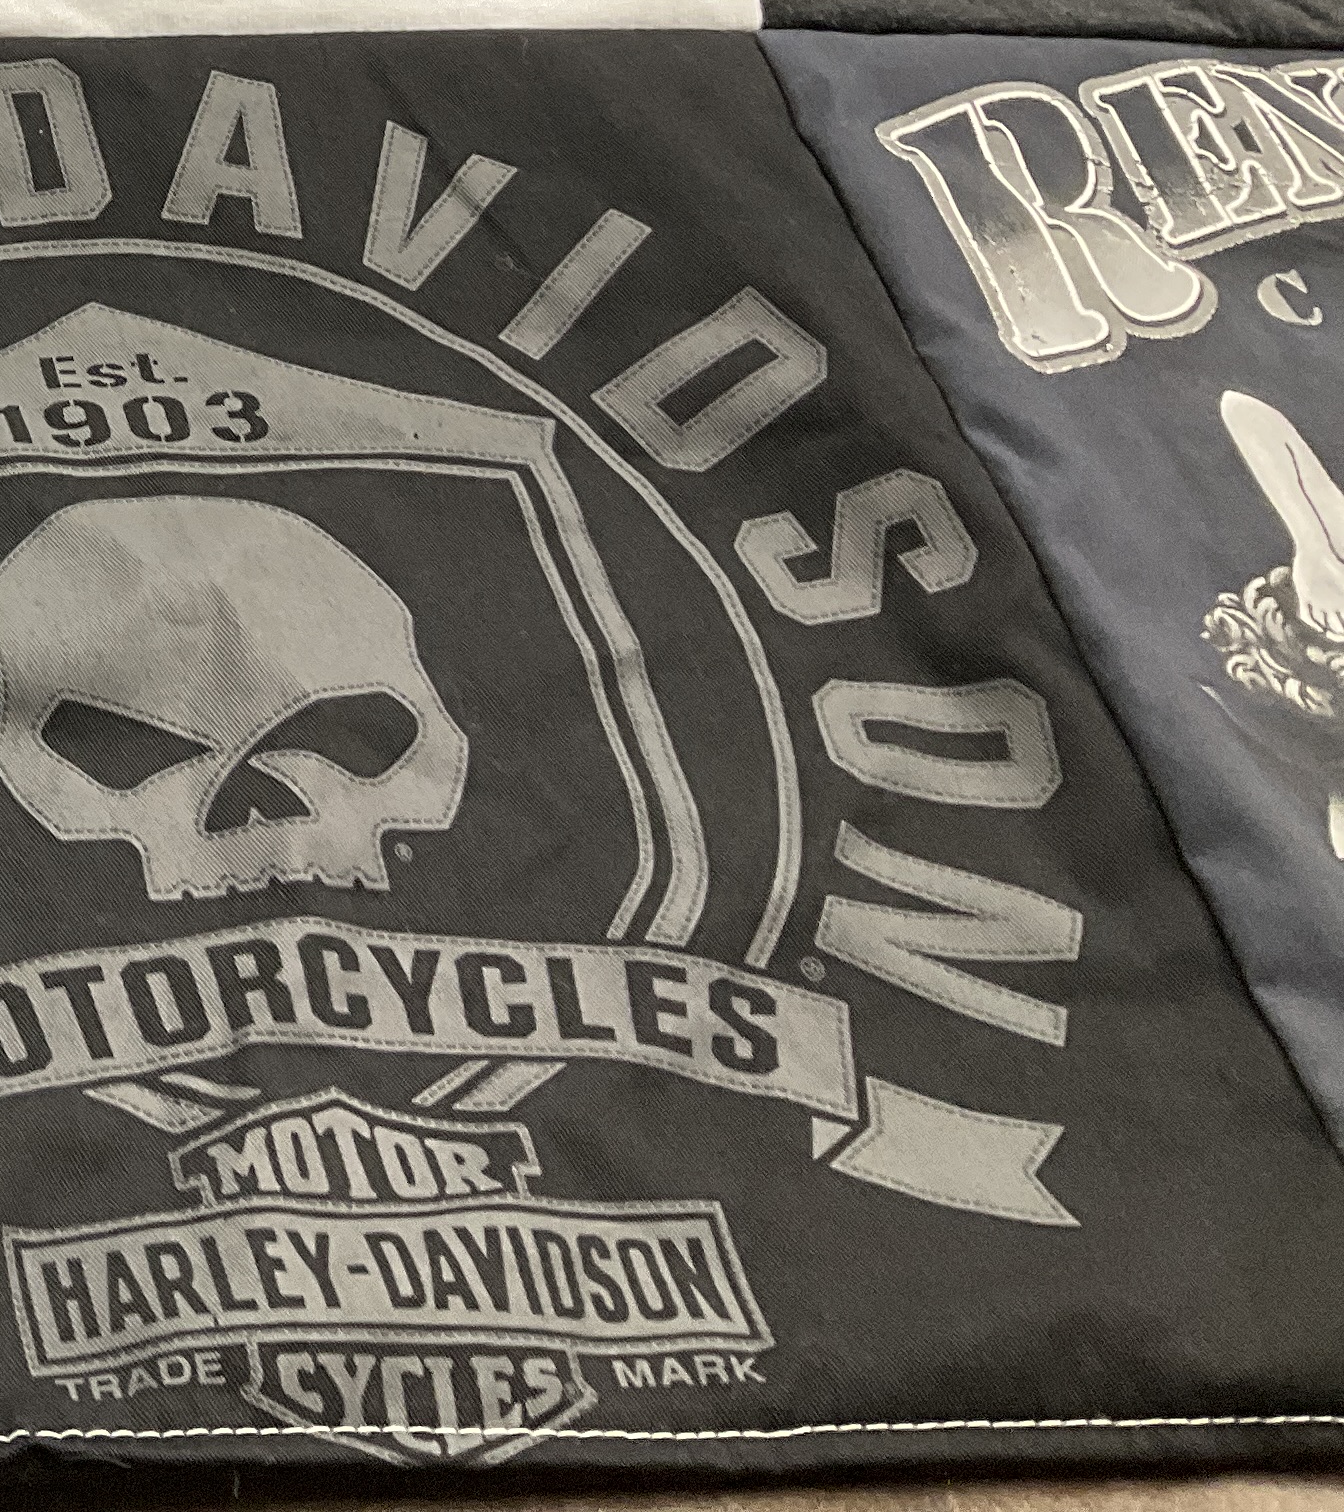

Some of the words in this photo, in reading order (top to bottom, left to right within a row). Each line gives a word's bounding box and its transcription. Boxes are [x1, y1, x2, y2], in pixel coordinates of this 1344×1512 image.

[38, 352, 190, 390] Est.
[205, 1106, 503, 1202] MOTOR
[39, 1224, 734, 1346] HARLEY-DAVIDSON
[54, 1350, 228, 1403] TRADE
[611, 1355, 767, 1391] MARK
[276, 1350, 569, 1456] CYCLES
